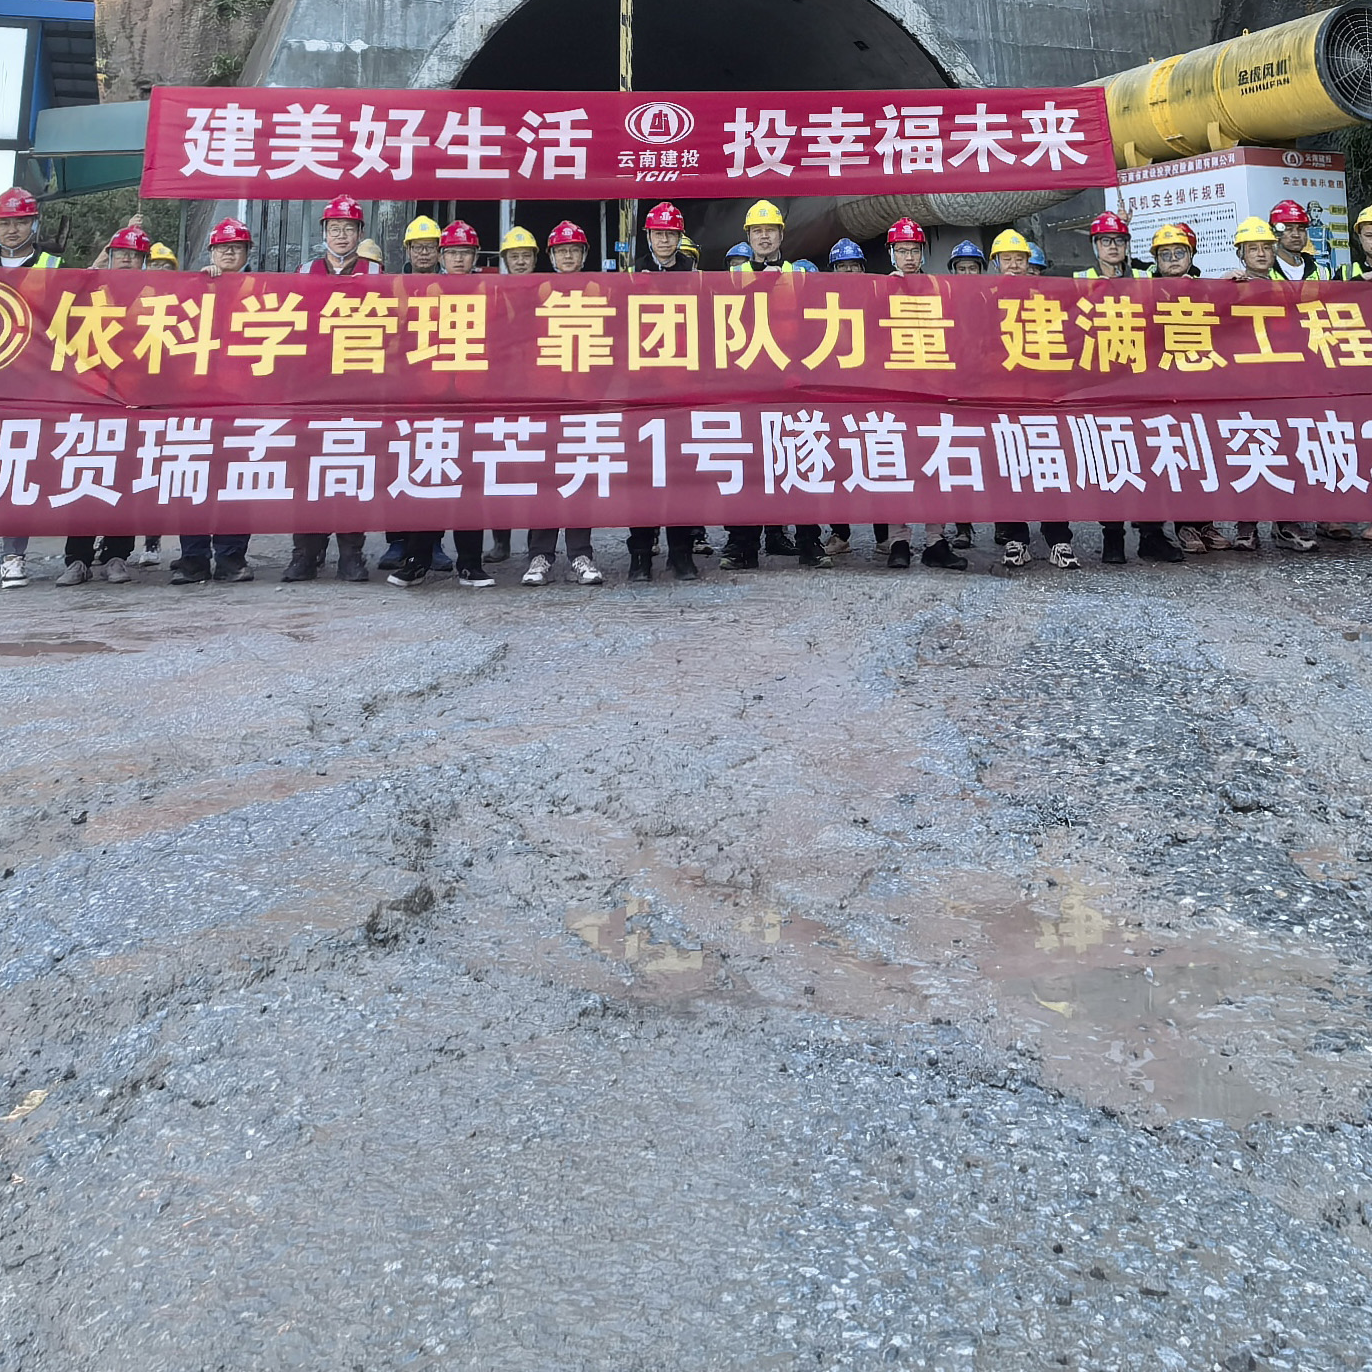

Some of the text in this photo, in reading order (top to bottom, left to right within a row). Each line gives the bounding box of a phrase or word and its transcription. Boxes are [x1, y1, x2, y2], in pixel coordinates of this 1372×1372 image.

[182, 101, 1087, 181] 建美好生活 投幸福未来
[618, 149, 700, 168] 云南建投
[635, 170, 679, 182] YCIH
[1118, 183, 1226, 211] 风机安全操作规程
[48, 290, 489, 378] 依科学管理
[535, 290, 956, 374] 靠团队力量
